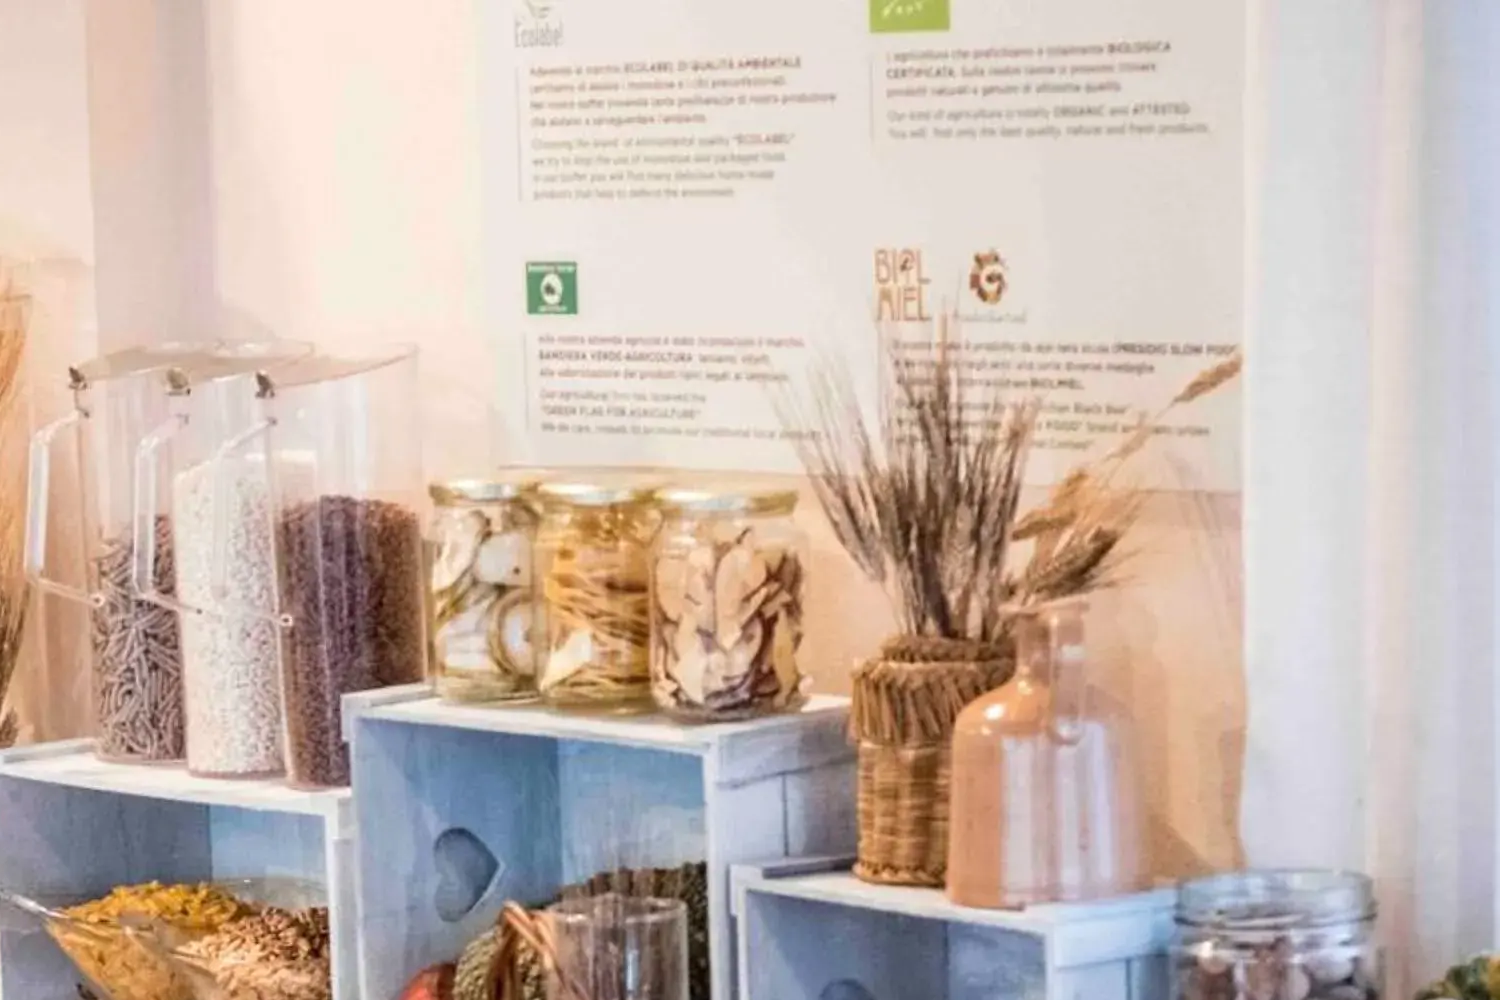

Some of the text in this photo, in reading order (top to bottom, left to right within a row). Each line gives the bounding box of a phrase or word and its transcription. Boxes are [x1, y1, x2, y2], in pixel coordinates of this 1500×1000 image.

[514, 18, 564, 48] Ecolabel
[1107, 40, 1171, 54] BIOLOGICA
[624, 60, 673, 73] ECOLABEL
[738, 55, 802, 69] AMBIENTALE
[1054, 103, 1105, 117] ORGANIC
[876, 285, 932, 321] MIEL
[539, 350, 587, 362] BANDIERA
